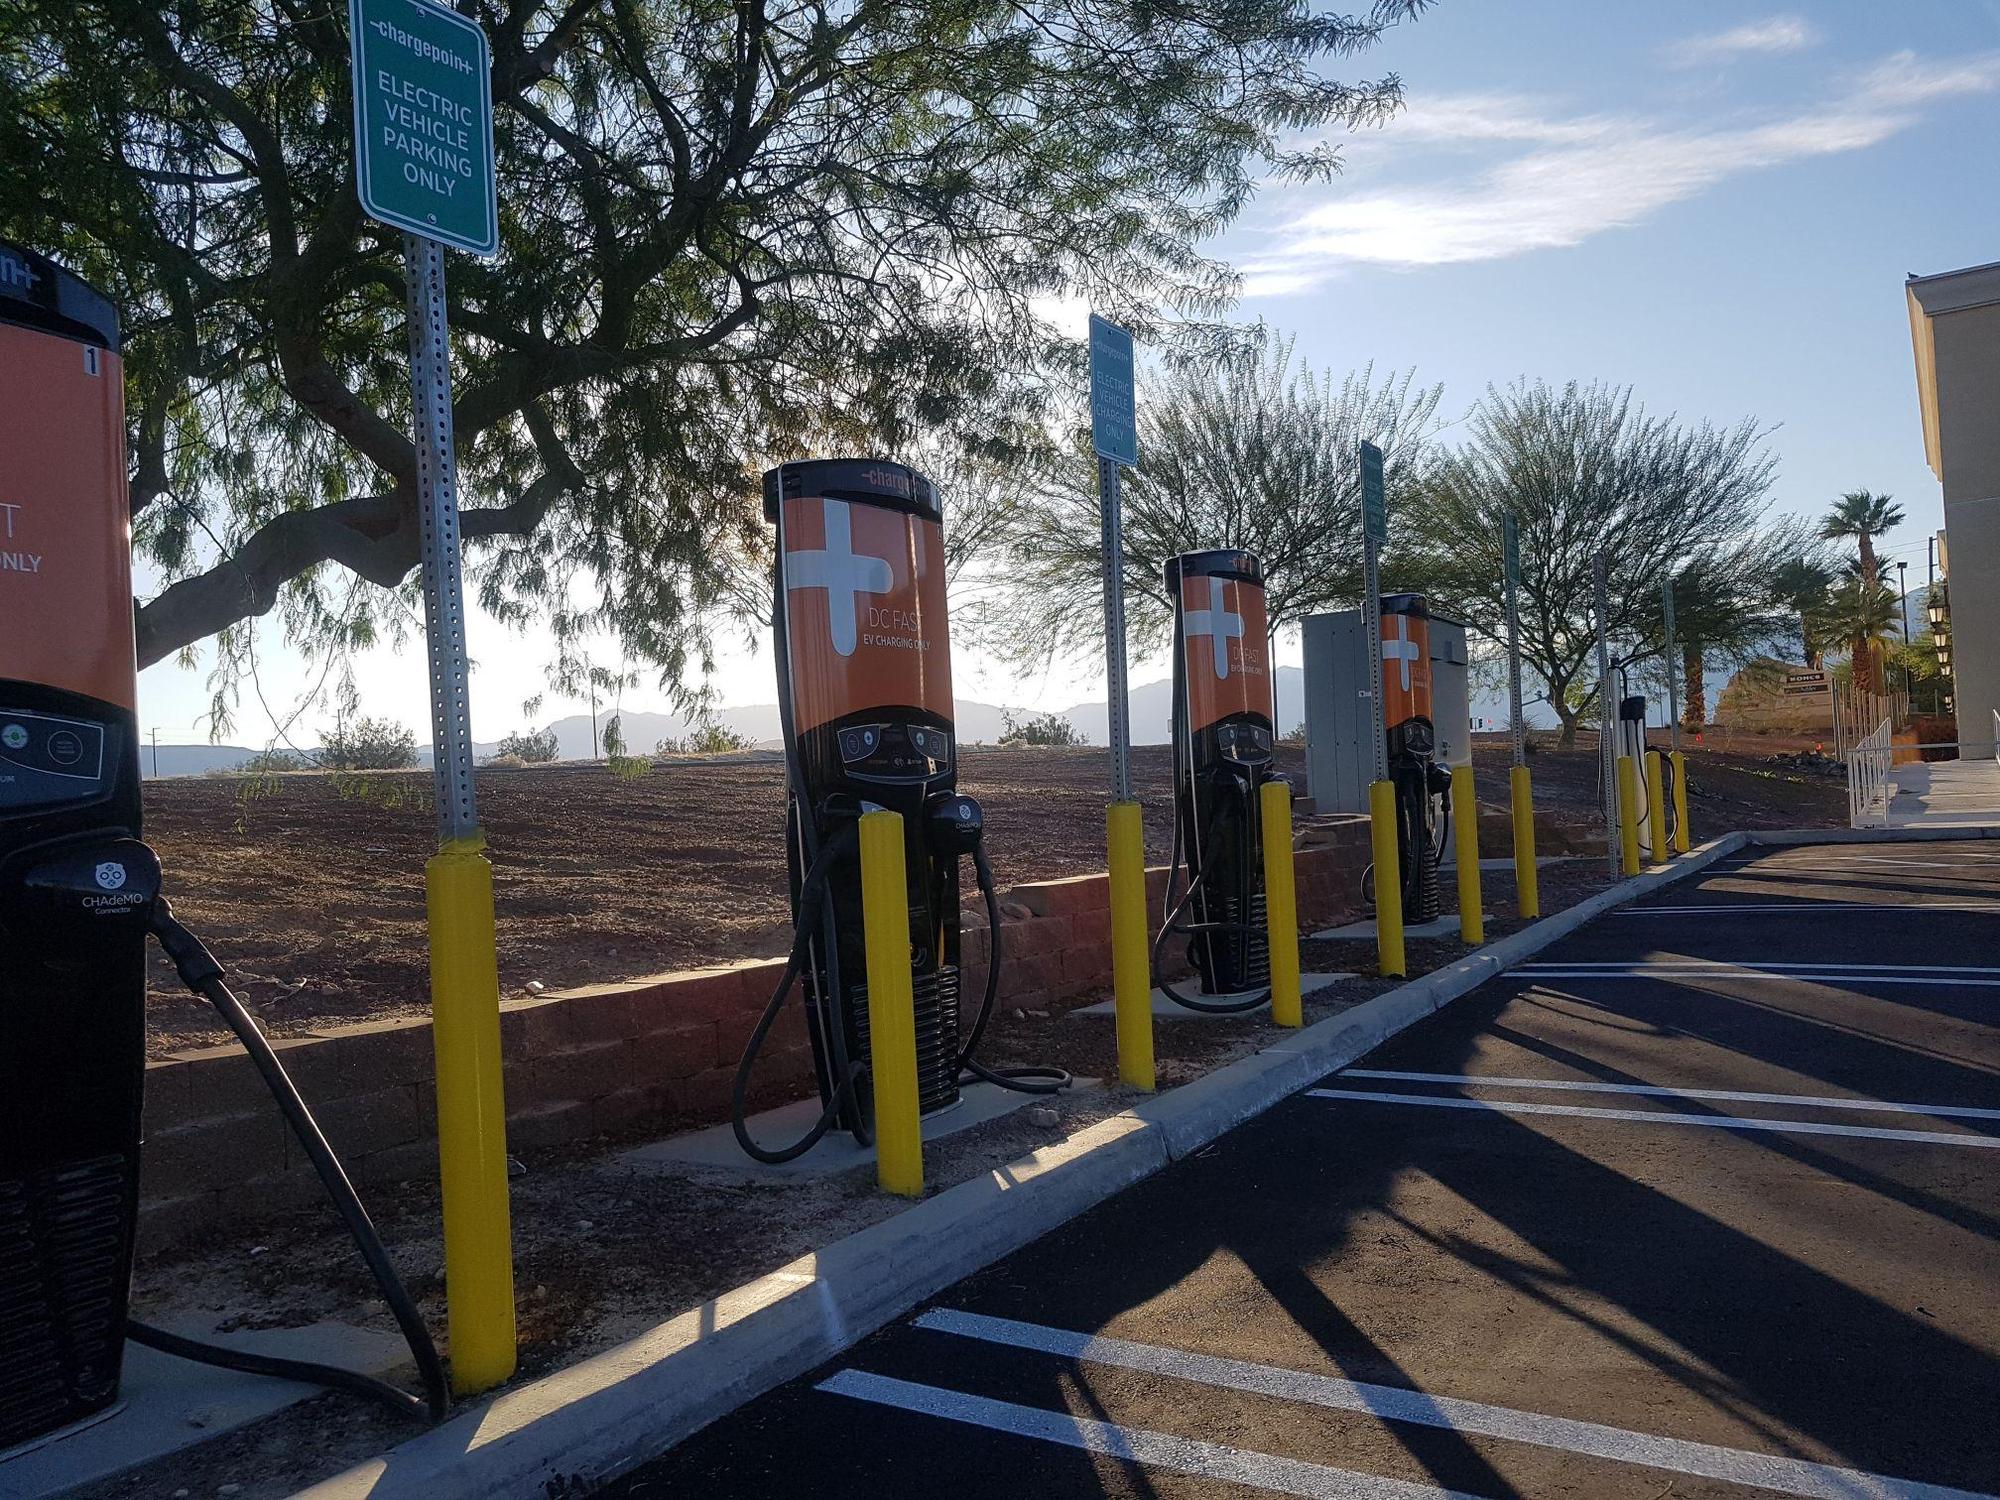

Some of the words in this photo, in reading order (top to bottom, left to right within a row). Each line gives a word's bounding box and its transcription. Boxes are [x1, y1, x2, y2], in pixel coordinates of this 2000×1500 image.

[378, 70, 472, 127] ELECTRIC
[384, 99, 469, 152] VEHICLE
[383, 126, 472, 178] PARKING
[403, 162, 456, 197] ONLY
[88, 346, 97, 374] 1
[1096, 371, 1130, 396] ELECTRIC
[1099, 388, 1129, 411] VEHICLE
[1096, 402, 1132, 428] CHARGING
[1105, 423, 1124, 441] ONLY
[0, 551, 42, 573] NLY
[869, 607, 890, 629] DC
[893, 609, 924, 632] FAST
[863, 634, 874, 645] EV
[875, 634, 913, 649] CHARGING
[82, 893, 143, 908] CHAdeMO
[95, 906, 131, 915] Connector
